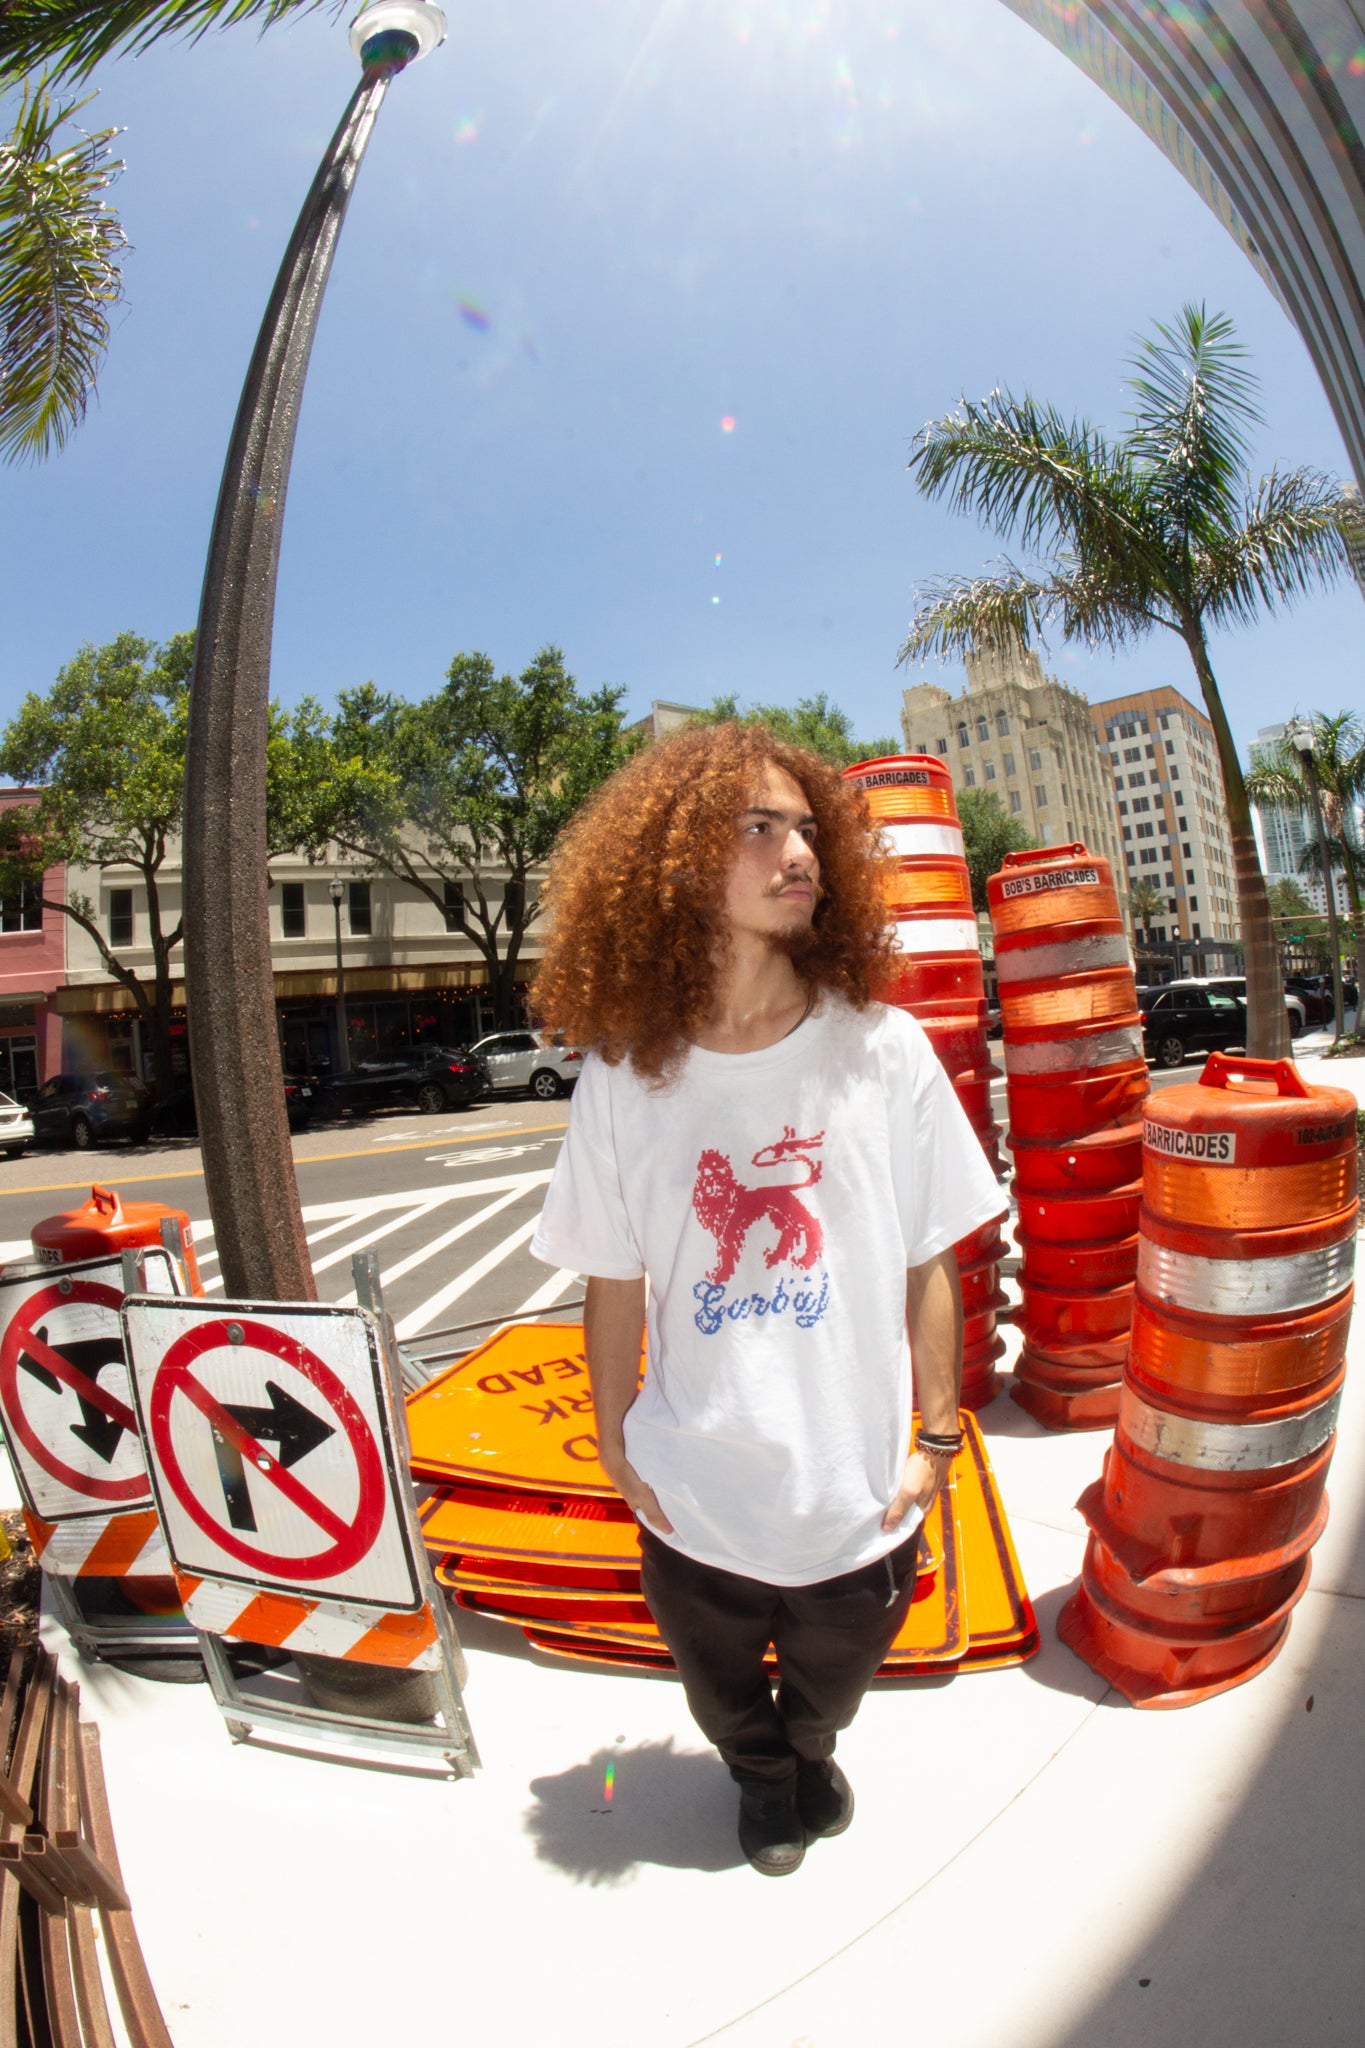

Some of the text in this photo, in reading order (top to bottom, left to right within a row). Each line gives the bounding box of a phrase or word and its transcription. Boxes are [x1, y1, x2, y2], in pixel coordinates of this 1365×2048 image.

[865, 772, 928, 788] BARRICADES
[1004, 869, 1097, 897] BOB'S BARRICADES
[1147, 1123, 1230, 1160] BARRICADES
[476, 1353, 588, 1395] EAD
[519, 1389, 594, 1426] RK
